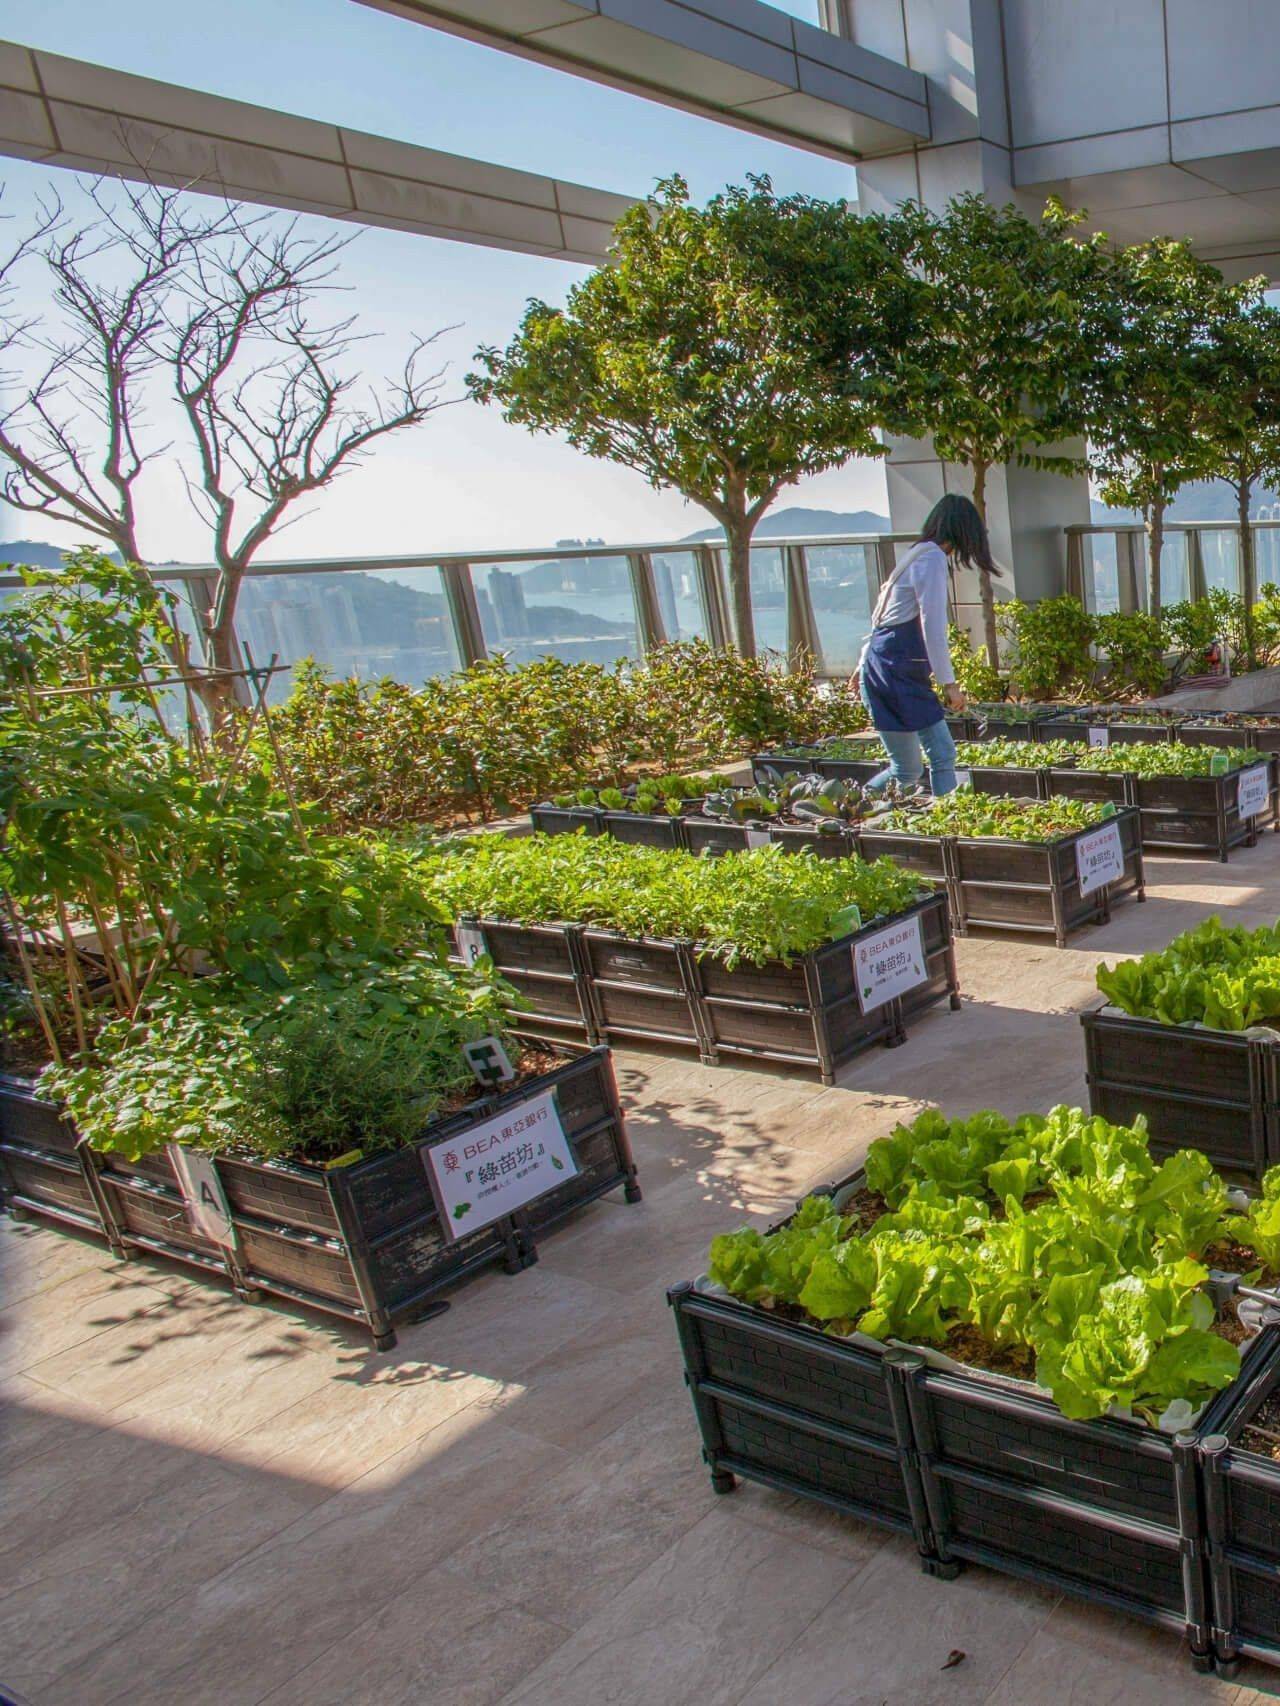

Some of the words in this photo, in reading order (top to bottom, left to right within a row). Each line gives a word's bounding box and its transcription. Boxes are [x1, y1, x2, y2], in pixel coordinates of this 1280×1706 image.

[869, 941, 889, 957] BEA
[463, 1134, 501, 1160] BEA
[502, 1107, 548, 1143] 東亞銀行
[201, 1181, 221, 1212] A
